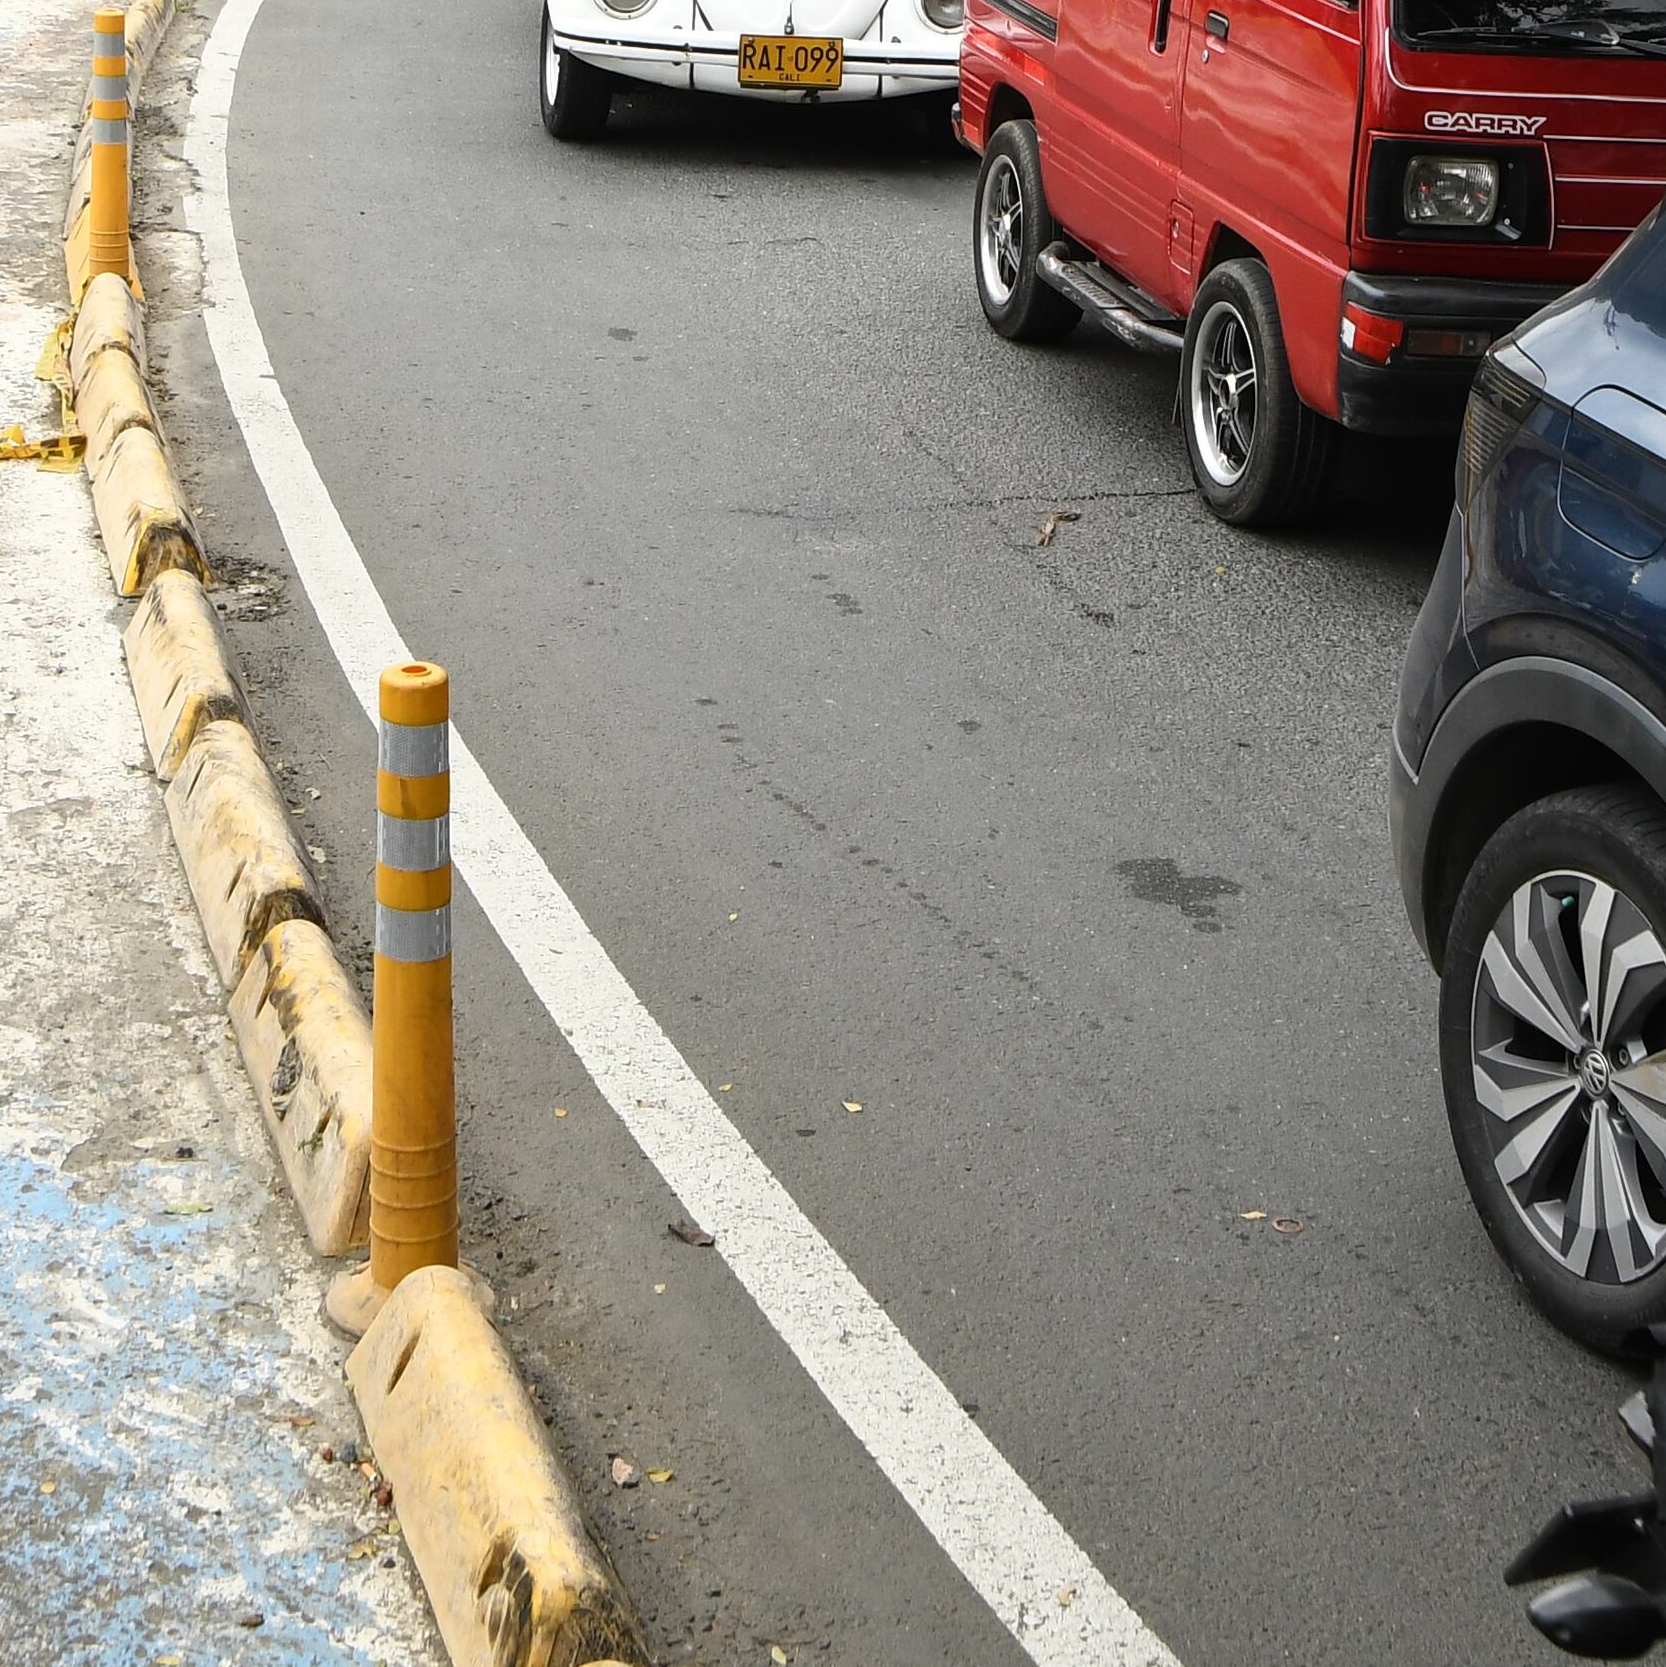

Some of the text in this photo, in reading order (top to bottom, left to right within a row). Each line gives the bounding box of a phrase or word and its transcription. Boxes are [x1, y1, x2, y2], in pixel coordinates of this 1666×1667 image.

[742, 43, 839, 73] RAI 099
[778, 73, 801, 82] CALI
[1424, 111, 1547, 135] CARRY
